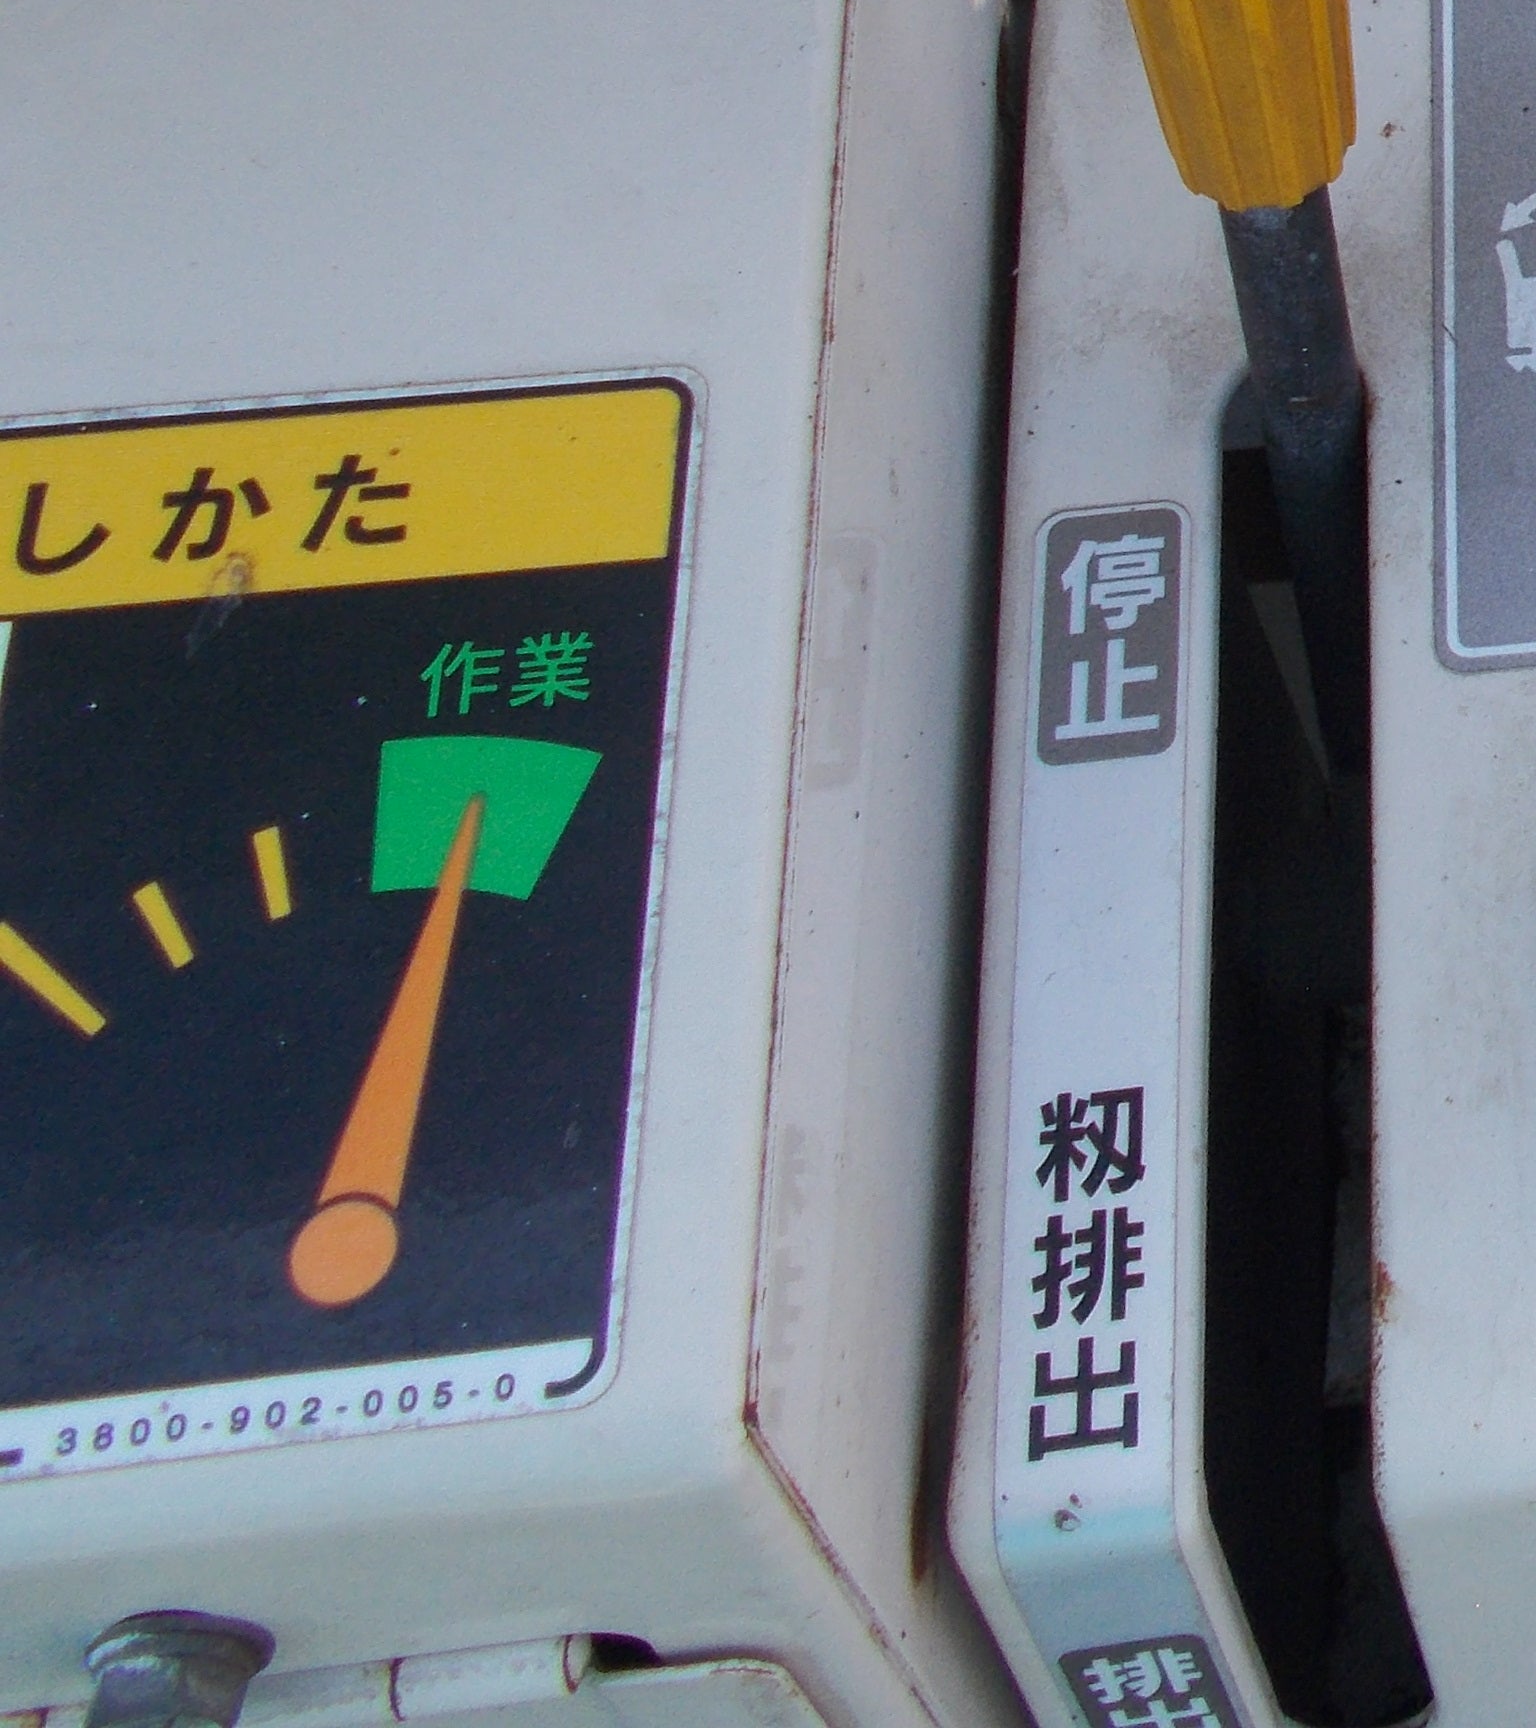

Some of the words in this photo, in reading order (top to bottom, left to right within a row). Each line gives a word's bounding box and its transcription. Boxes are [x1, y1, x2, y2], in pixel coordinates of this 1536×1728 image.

[14, 453, 412, 576] しかた
[419, 630, 595, 719] 作業
[1055, 535, 1168, 744] 停止
[1026, 1084, 1149, 1464] 籾排出
[55, 1372, 517, 1459] 3800-902-005-0
